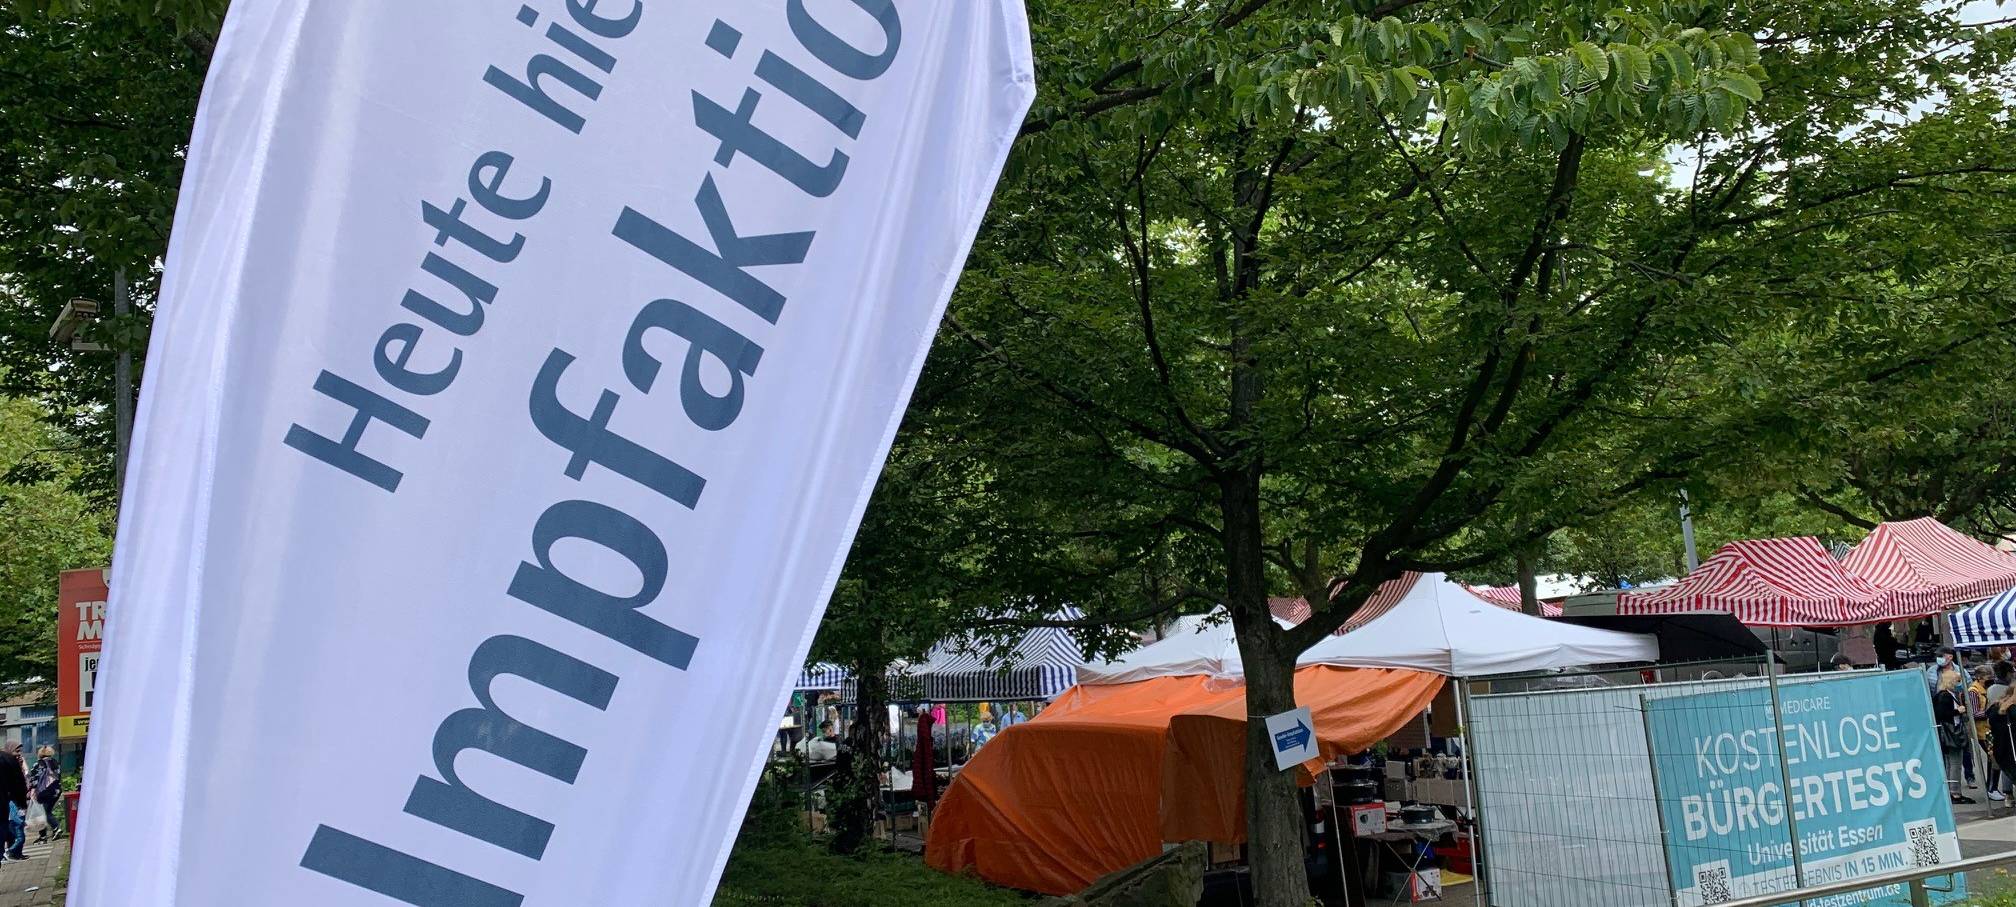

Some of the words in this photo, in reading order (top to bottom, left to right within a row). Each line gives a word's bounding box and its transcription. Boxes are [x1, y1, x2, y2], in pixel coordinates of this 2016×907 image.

[283, 150, 552, 493] Heute
[1780, 696, 1831, 714] MEDICARE
[1694, 710, 1901, 778] KOSTENLOSE
[1681, 758, 1928, 841] BÜRGERTESTS
[1748, 829, 1835, 866] Univesität
[1838, 823, 1883, 848] Essen
[1844, 860, 1860, 878] IN
[1861, 856, 1876, 874] 15
[1878, 851, 1909, 871] MIN.
